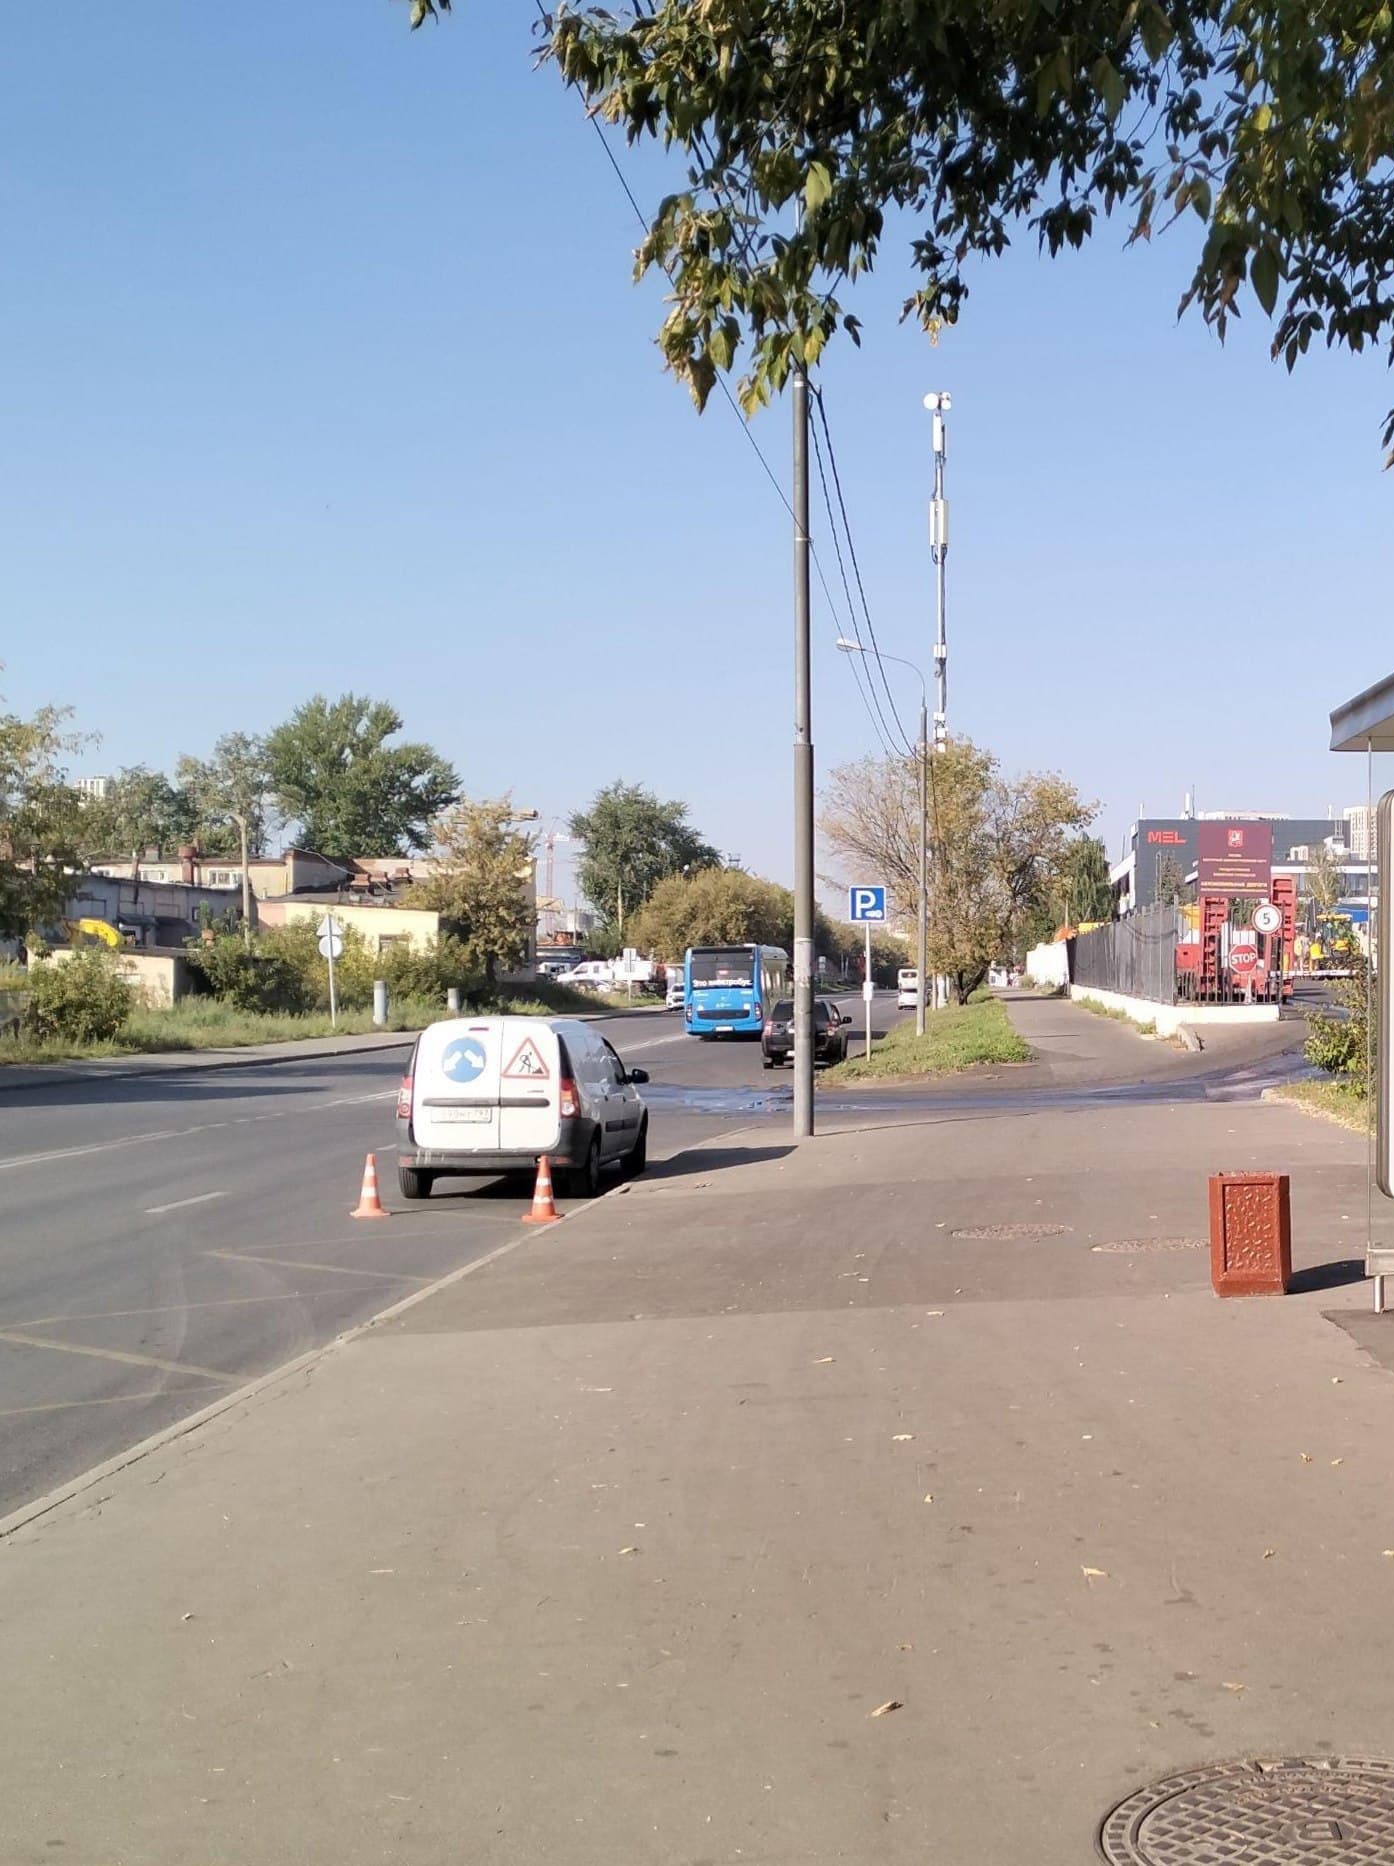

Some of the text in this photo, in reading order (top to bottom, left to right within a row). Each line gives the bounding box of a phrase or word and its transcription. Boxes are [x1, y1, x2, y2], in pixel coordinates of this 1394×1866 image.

[1147, 831, 1187, 843] MEL
[855, 890, 876, 918] P
[1262, 912, 1271, 925] 5
[1231, 953, 1256, 965] STOP
